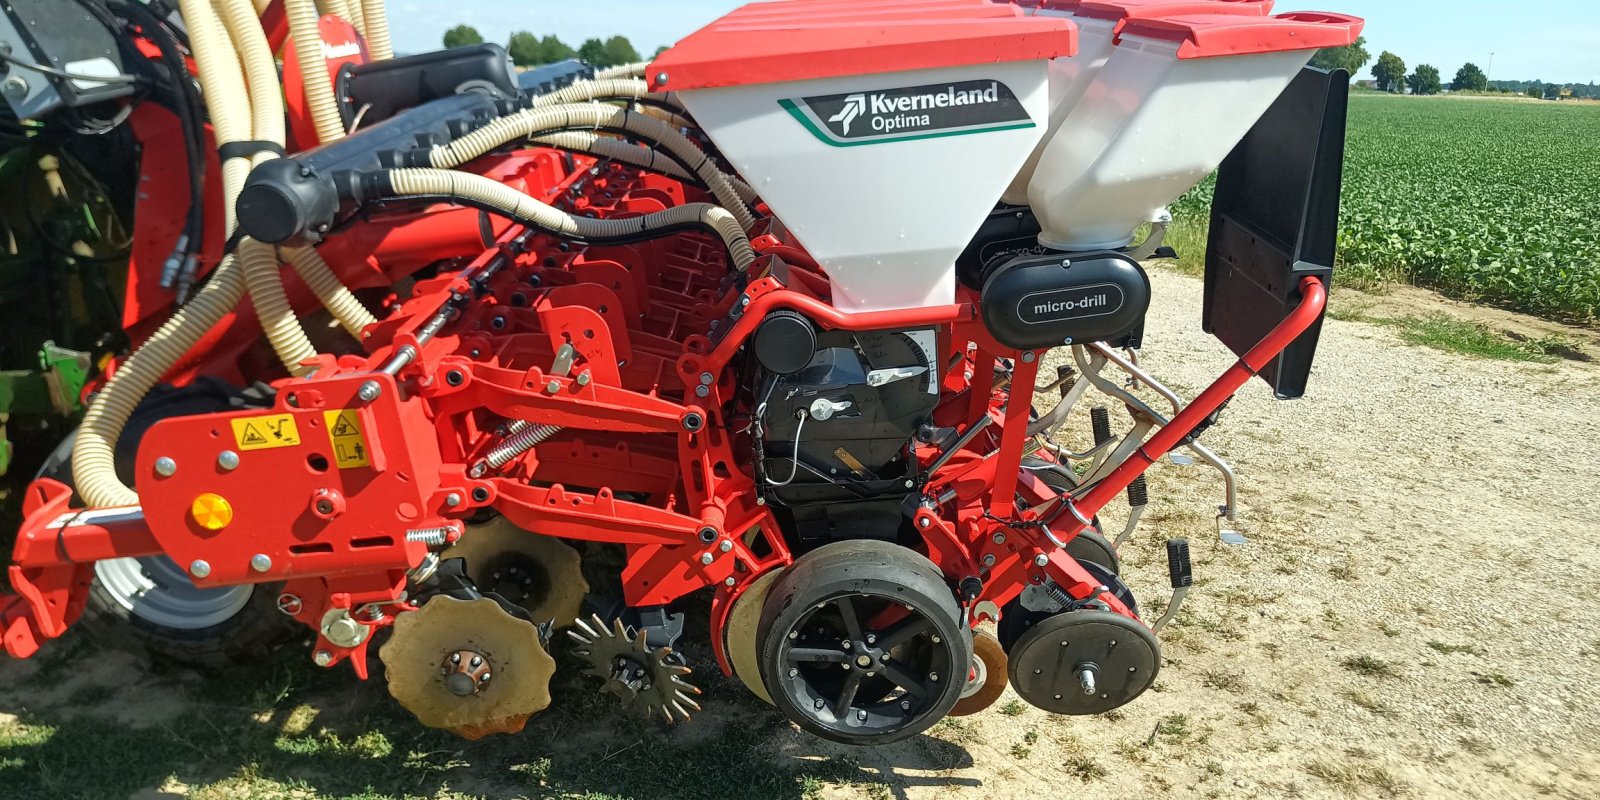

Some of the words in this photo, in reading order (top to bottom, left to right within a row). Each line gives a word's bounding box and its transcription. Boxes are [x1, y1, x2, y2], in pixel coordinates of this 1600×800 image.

[870, 82, 998, 114] Kverneland
[871, 114, 930, 132] Optima
[1034, 294, 1106, 314] micro-drill
